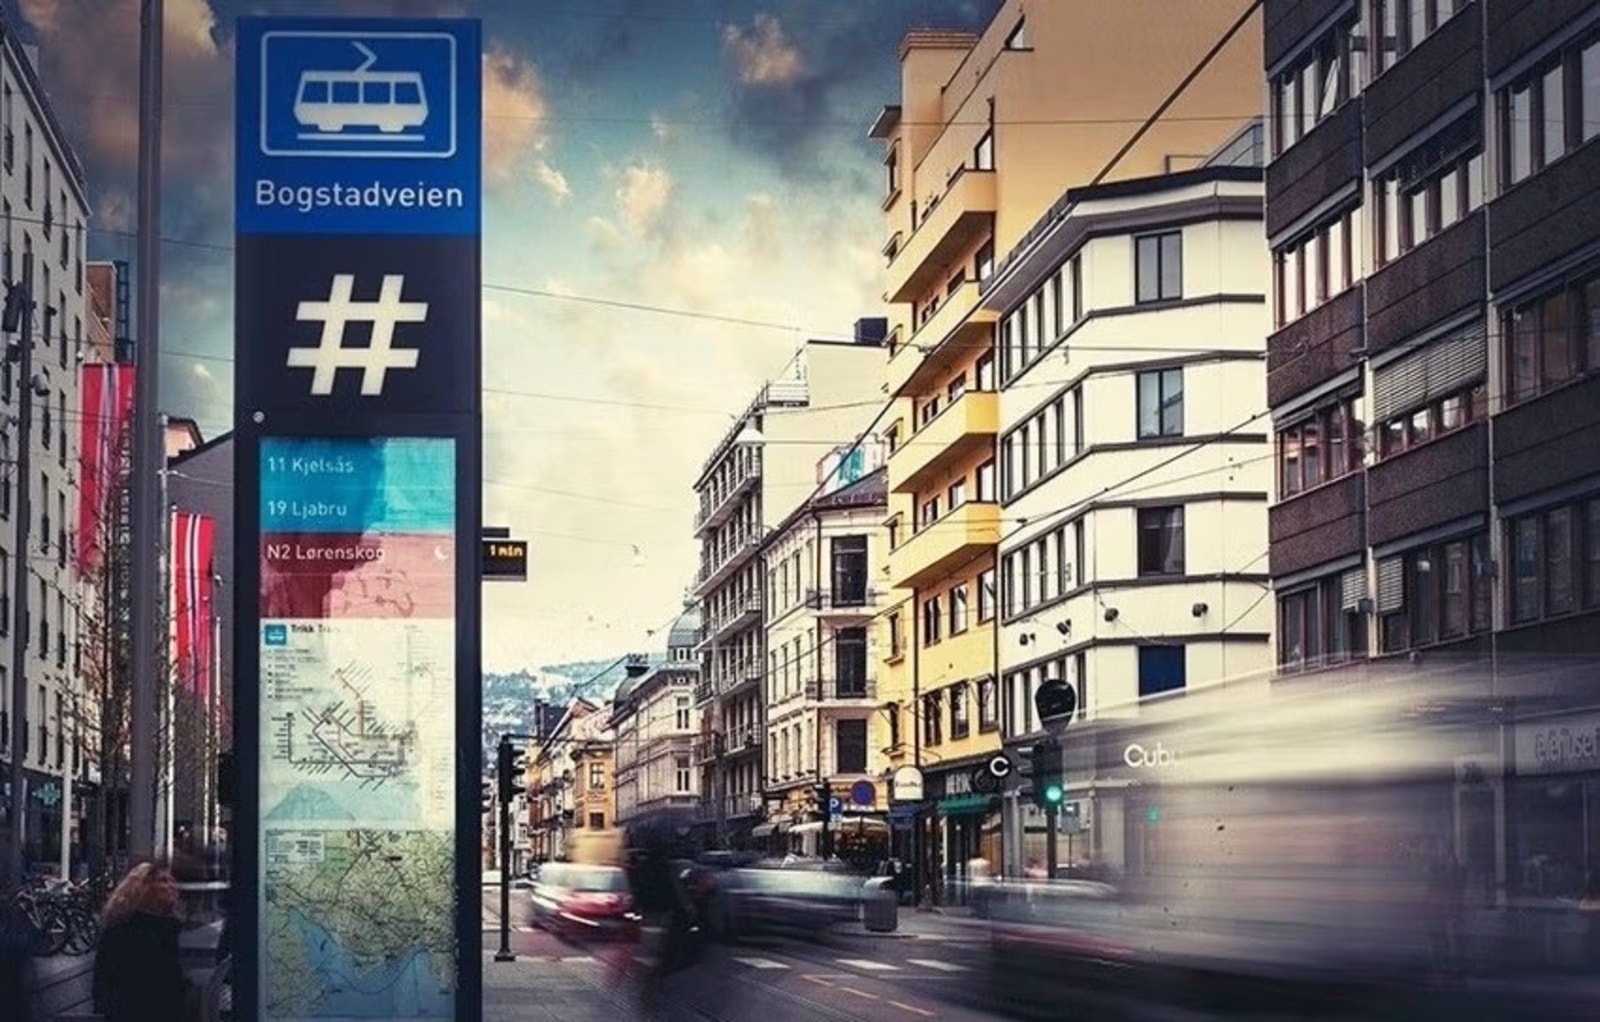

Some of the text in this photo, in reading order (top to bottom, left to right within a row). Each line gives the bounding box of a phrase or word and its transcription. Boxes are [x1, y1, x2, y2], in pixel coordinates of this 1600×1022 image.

[256, 180, 463, 213] Bogstadveien
[267, 455, 355, 476] 11 Kjelsås
[267, 500, 347, 519] 19 Ljabru
[266, 543, 291, 560] N2
[490, 544, 523, 556] 1 min
[989, 756, 1009, 776] C
[829, 797, 839, 812] P
